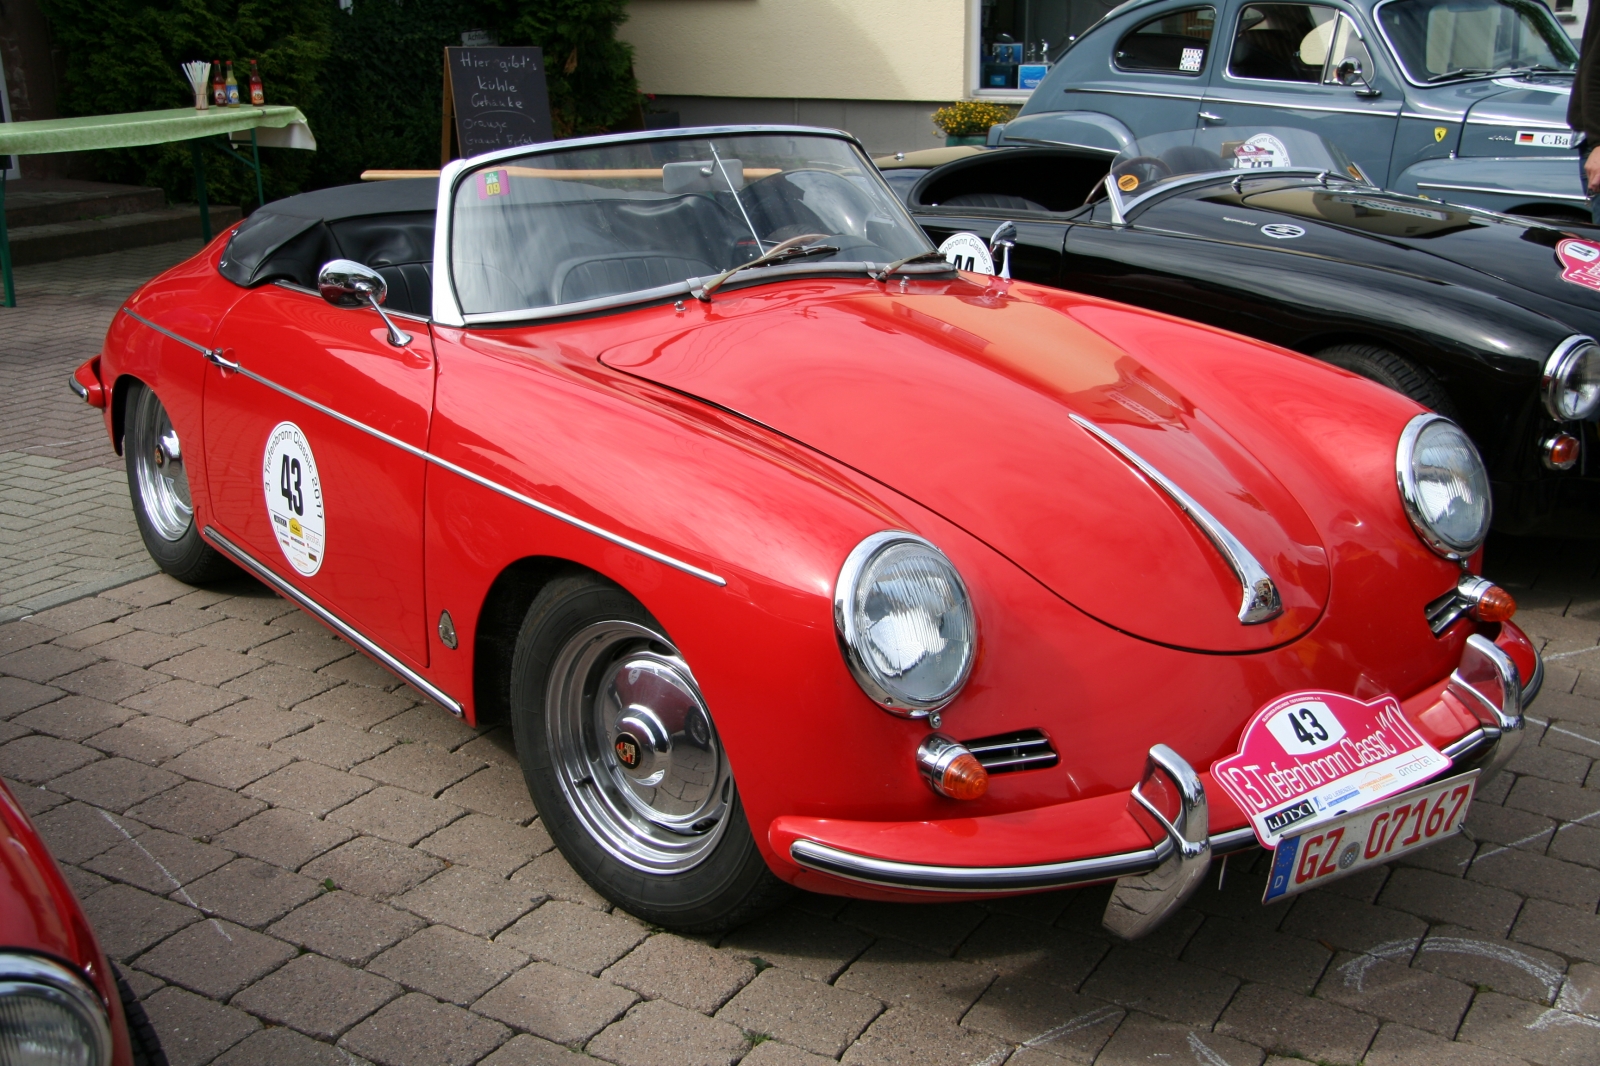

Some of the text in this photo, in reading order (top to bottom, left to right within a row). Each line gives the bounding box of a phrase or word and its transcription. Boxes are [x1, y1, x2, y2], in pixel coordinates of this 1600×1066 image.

[460, 51, 489, 68] Hier
[1541, 134, 1570, 146] C.Ba
[486, 182, 500, 196] 09
[968, 238, 988, 265] Classic
[265, 430, 293, 475] Tiefenbronn
[293, 431, 314, 474] Classic
[311, 476, 323, 518] 2011
[281, 453, 304, 517] 43
[1287, 708, 1329, 746] 43
[1340, 725, 1397, 767] Classic
[1398, 755, 1435, 777] ancotel
[1273, 784, 1470, 889] D GZ 07167
